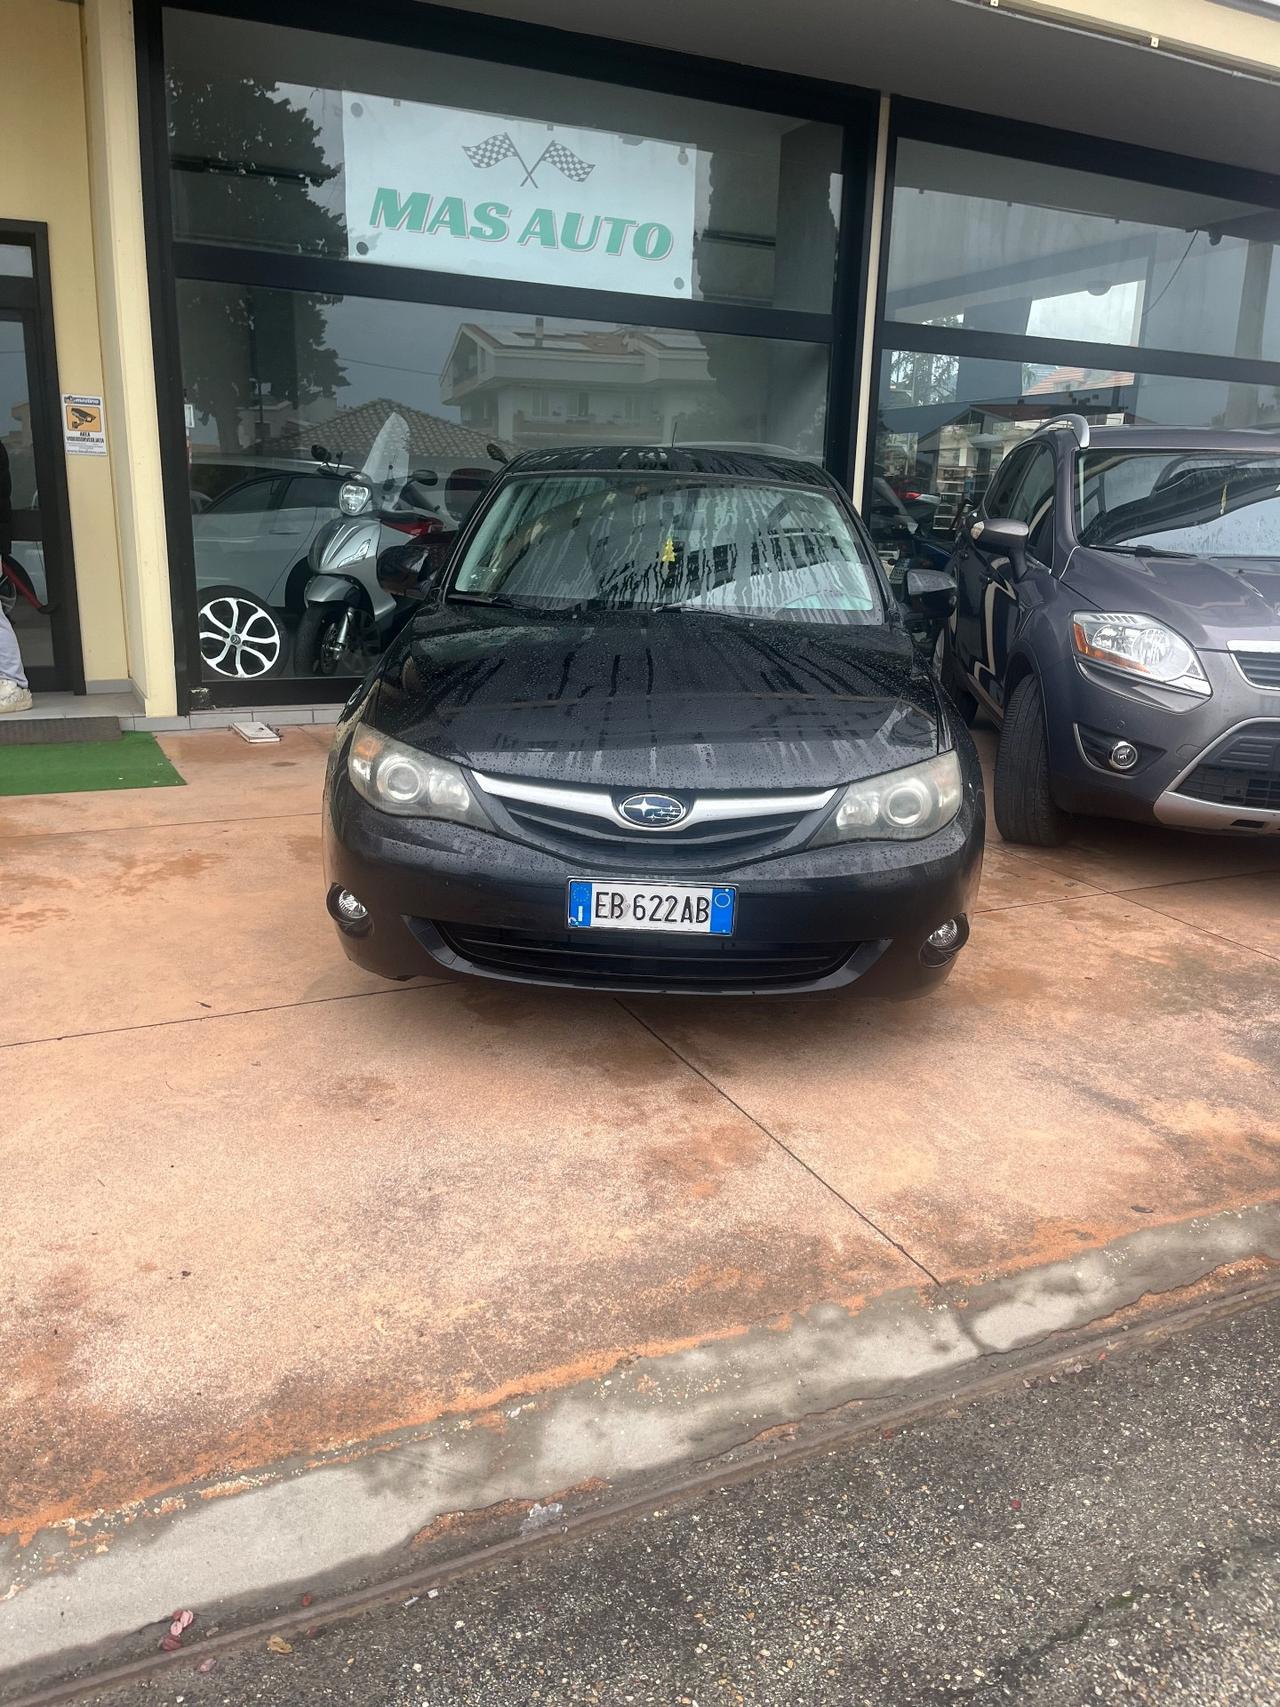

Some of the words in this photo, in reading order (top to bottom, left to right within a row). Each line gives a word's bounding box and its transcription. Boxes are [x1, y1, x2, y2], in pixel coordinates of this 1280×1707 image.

[369, 187, 511, 242] MAS
[517, 208, 673, 261] AUTO
[595, 891, 624, 919] EB
[633, 894, 710, 924] 622AB
